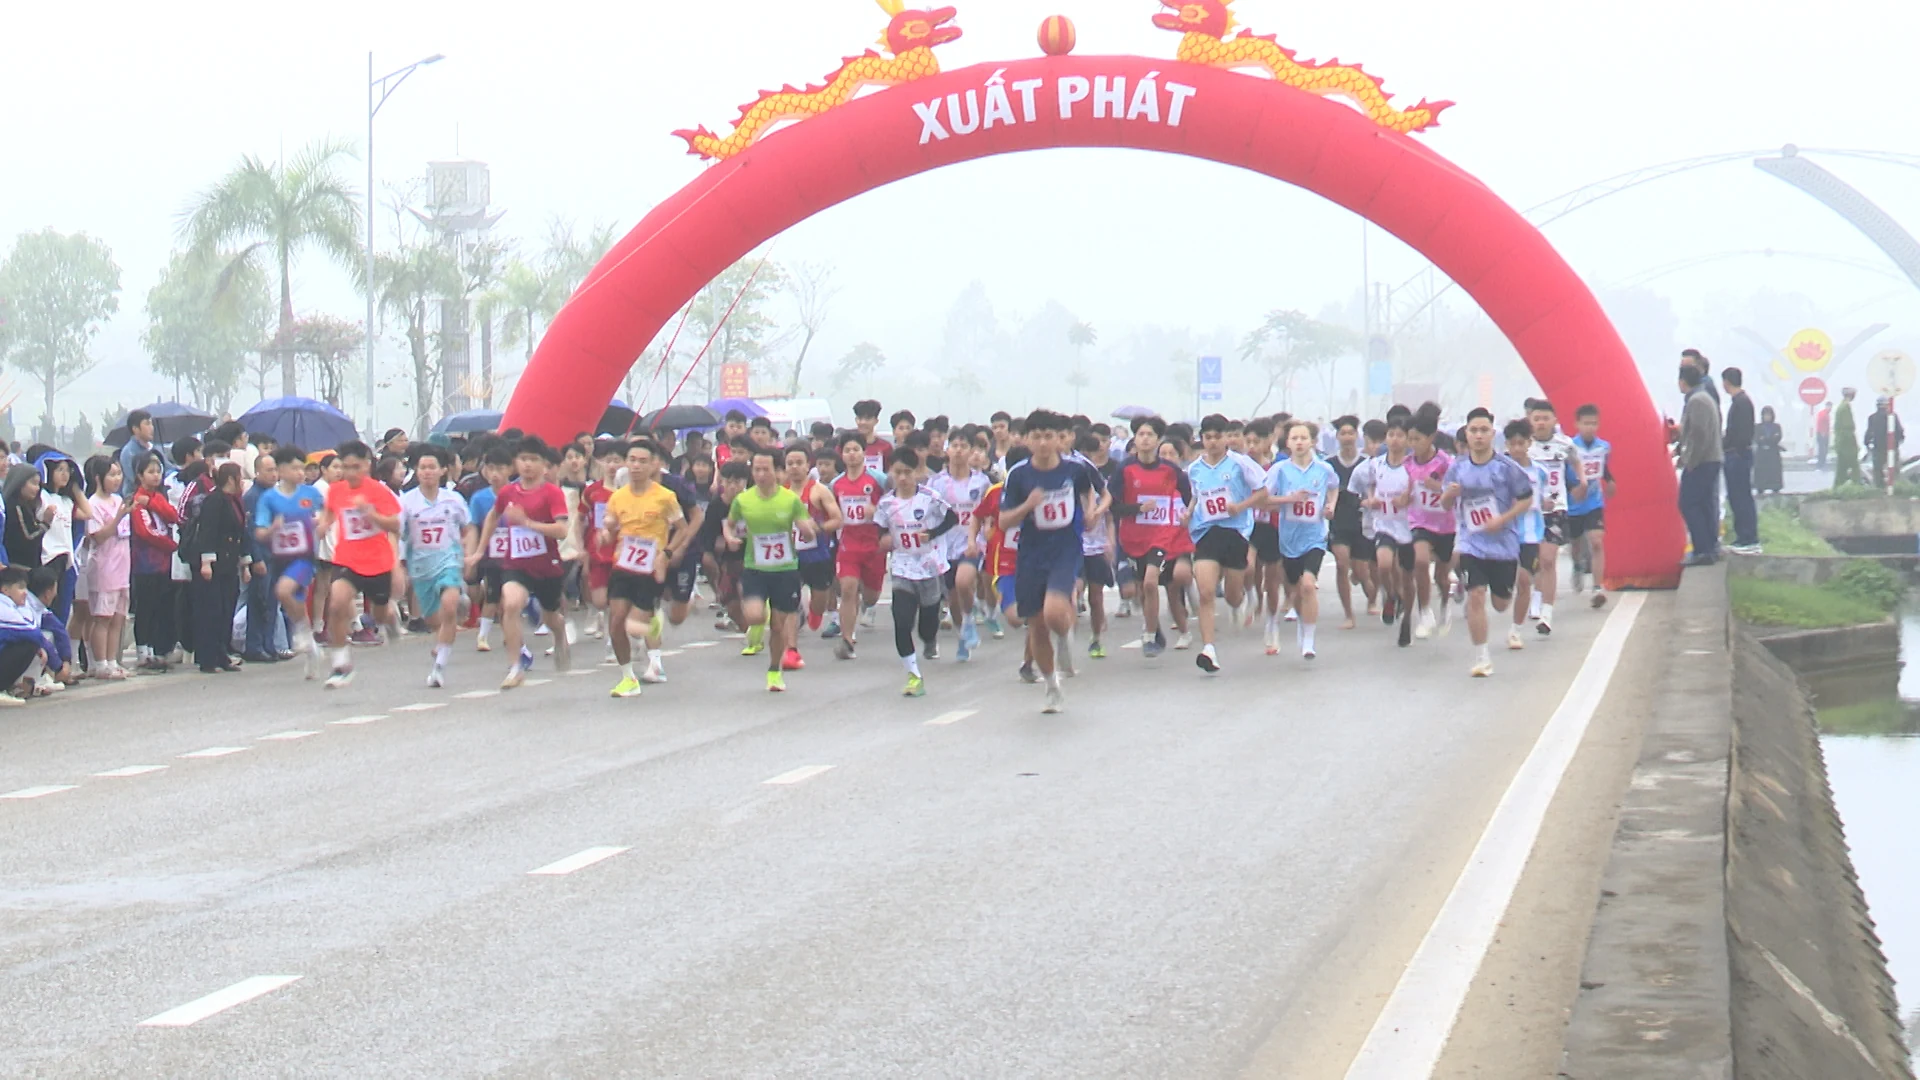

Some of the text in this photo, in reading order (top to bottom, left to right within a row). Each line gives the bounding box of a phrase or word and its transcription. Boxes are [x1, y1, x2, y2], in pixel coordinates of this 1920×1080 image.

[911, 68, 1197, 145] XUẤT PHÁT
[847, 505, 865, 520] 49
[1206, 497, 1227, 516] 68
[1293, 501, 1316, 517] 66
[421, 527, 443, 544] 57
[900, 532, 921, 549] 81
[516, 537, 541, 553] 104
[761, 543, 785, 560] 73
[628, 546, 649, 566] 72
